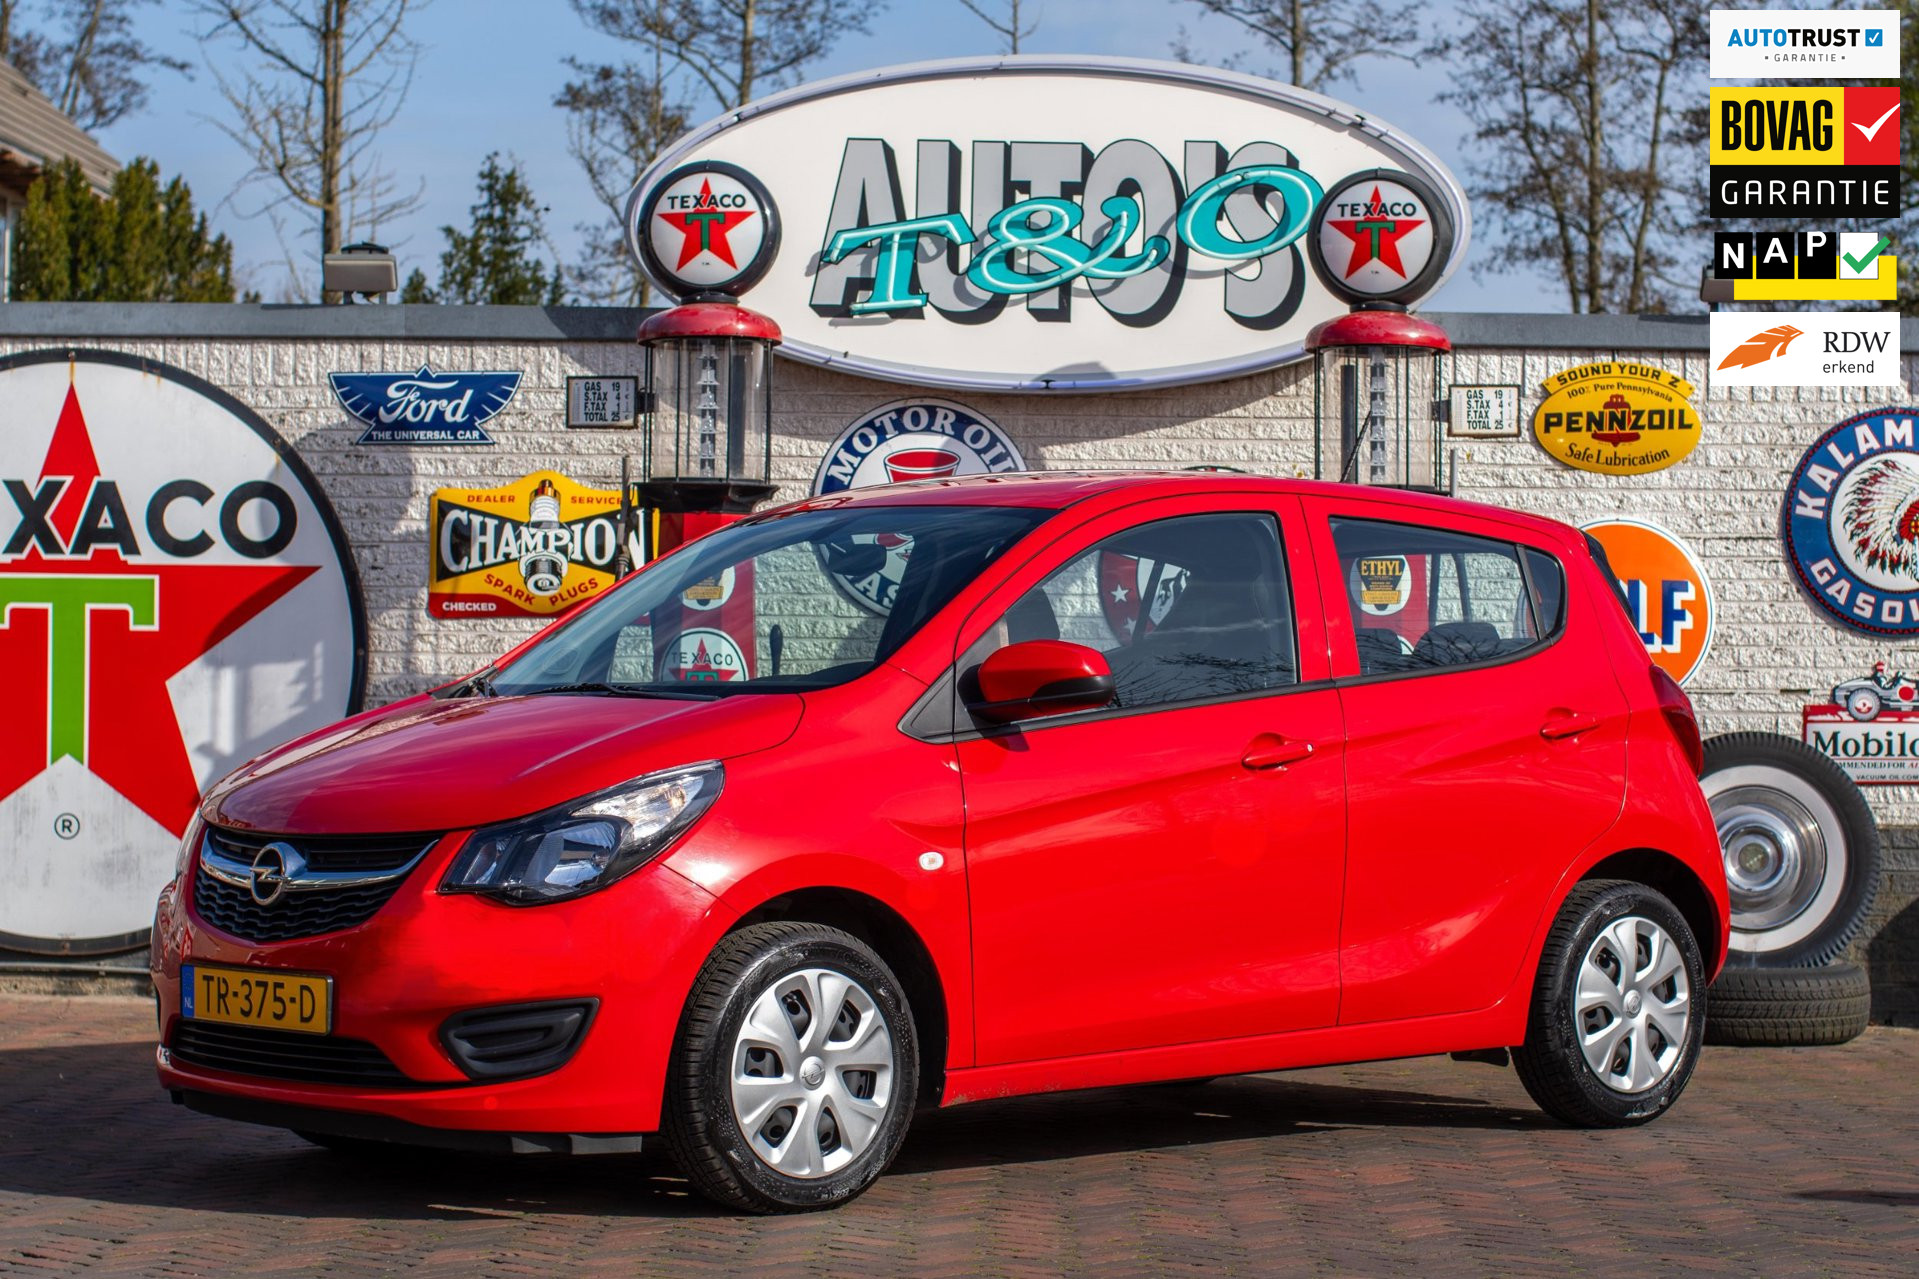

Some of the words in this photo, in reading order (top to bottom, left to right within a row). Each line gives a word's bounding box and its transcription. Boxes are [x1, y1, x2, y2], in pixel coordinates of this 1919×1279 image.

[667, 194, 746, 209] TEXACO
[1337, 202, 1416, 217] TEXACO
[1557, 364, 1612, 385] SOUND
[1618, 364, 1661, 381] YOUR
[1668, 376, 1681, 389] Z
[584, 381, 601, 391] GAS
[612, 382, 620, 391] 19
[1594, 382, 1615, 392] Pure
[1617, 382, 1673, 403] Pennsylvania
[378, 379, 474, 424] Ford
[584, 392, 608, 401] S.TAX
[616, 392, 620, 400] 4
[1466, 389, 1483, 399] GAS
[1494, 389, 1503, 399] 19
[584, 402, 606, 411] F.TAX
[1467, 400, 1490, 409] S.TAX
[1498, 400, 1503, 409] 4
[584, 412, 608, 421] TOTAL
[611, 412, 620, 421] 25
[1467, 410, 1489, 419] F.TAX
[1544, 408, 1694, 434] PENNZOIL
[1467, 420, 1491, 430] TOTAL
[1494, 420, 1503, 430] 25
[371, 430, 392, 441] THE
[394, 430, 453, 440] UNIVERSAL
[457, 430, 480, 440] CAR
[827, 406, 957, 486] MOTOR
[1565, 442, 1594, 463] Safe
[1596, 448, 1670, 467] Lubrication
[1795, 418, 1914, 520] KALAM
[467, 494, 515, 503] DEALER
[2, 479, 298, 560] XACO
[1361, 560, 1402, 576] ETHYL
[484, 573, 536, 605] SPARK
[549, 578, 599, 606] PLUGS
[854, 571, 900, 607] AS
[442, 602, 497, 611] CHECKED
[1621, 579, 1696, 654] LF
[671, 652, 733, 666] TEXACO
[184, 997, 194, 1009] NL
[202, 974, 316, 1024] TR-375-D
